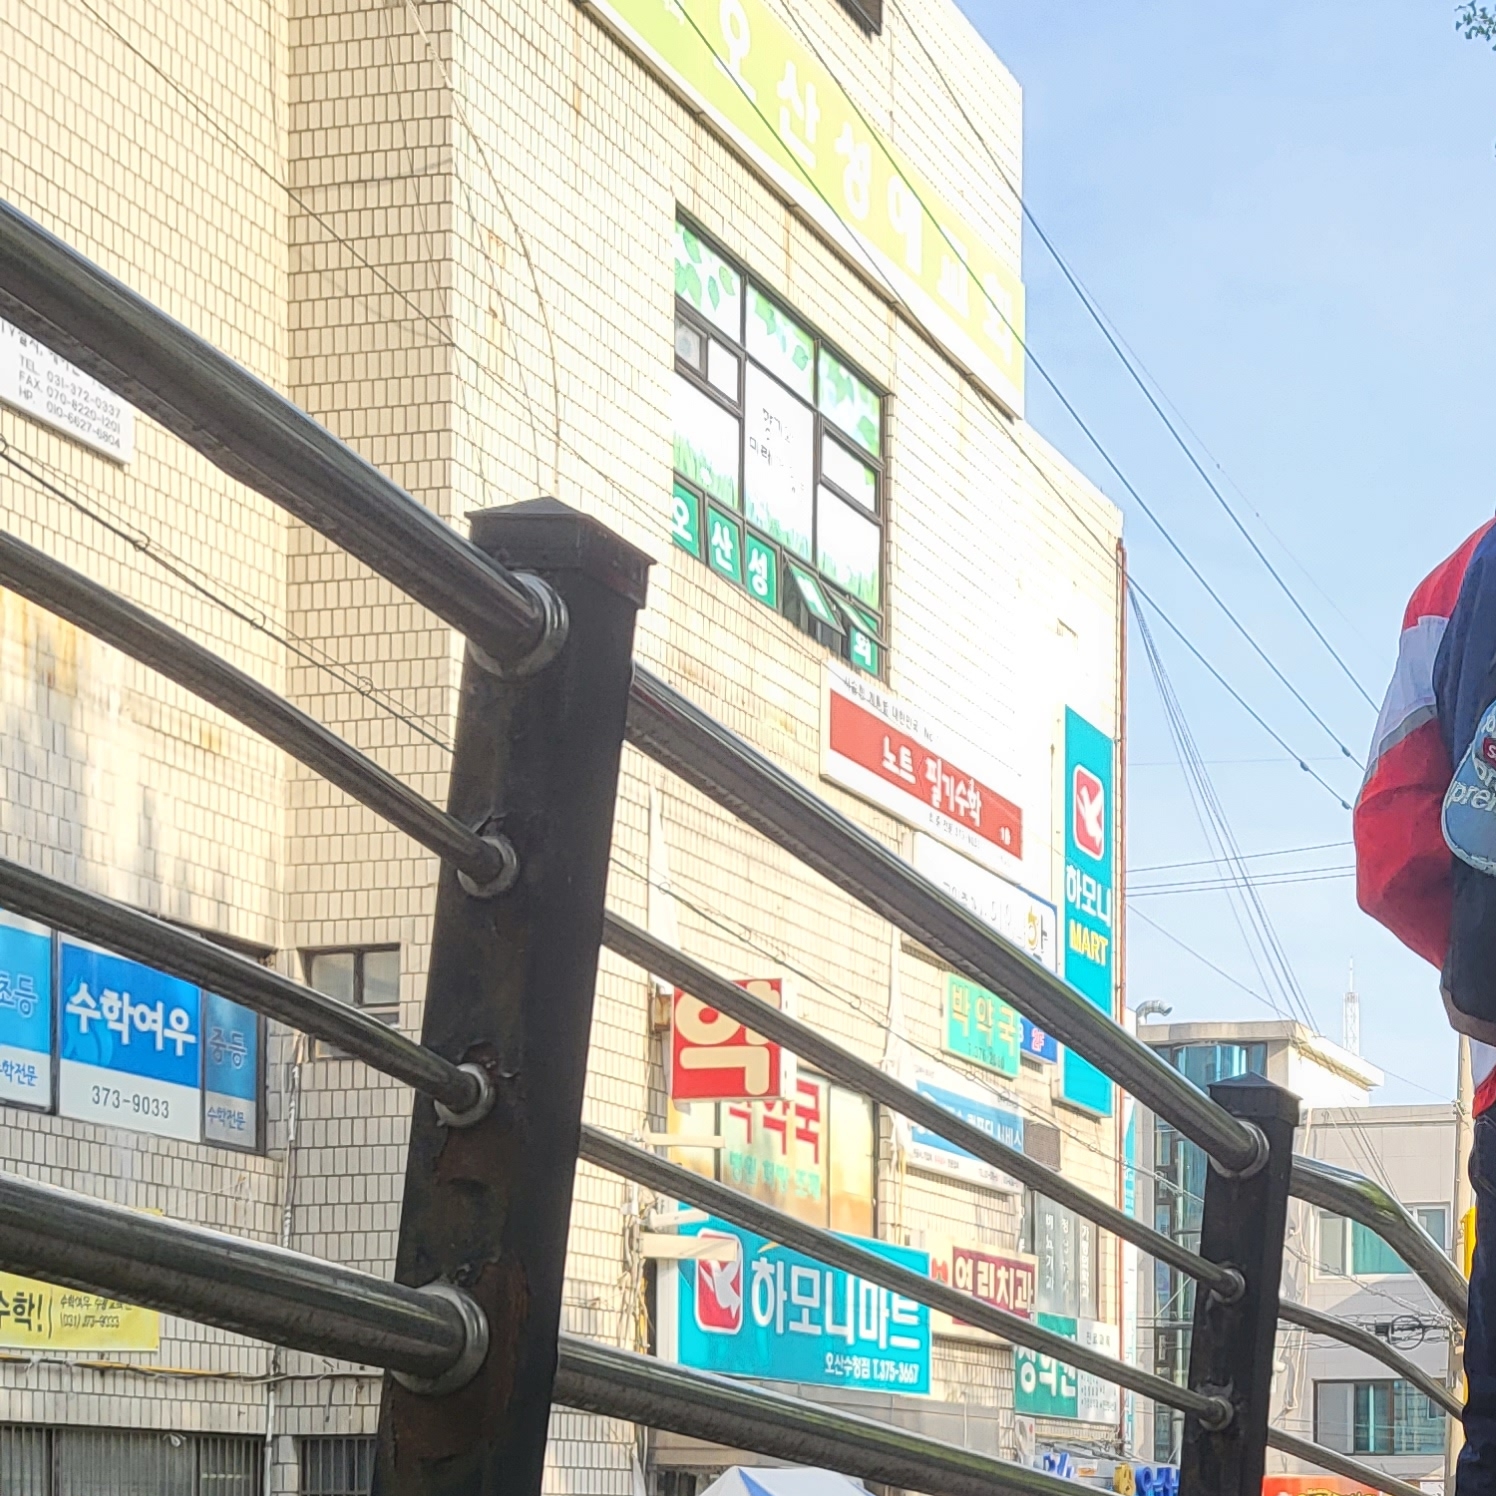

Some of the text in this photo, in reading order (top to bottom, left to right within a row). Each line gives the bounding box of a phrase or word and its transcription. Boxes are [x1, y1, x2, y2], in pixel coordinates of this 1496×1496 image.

[882, 735, 982, 828] 노트 필기수학
[1066, 865, 1111, 927] 하모니
[1069, 918, 1108, 967] MART
[66, 982, 197, 1057] 수학여우
[209, 1026, 248, 1069] 중등
[674, 980, 781, 1096] 약
[952, 983, 1017, 1057] 박약국
[92, 1084, 170, 1119] 373-9033
[207, 1105, 247, 1132] 수학전문
[751, 1257, 921, 1350] 하모니마트
[824, 1352, 870, 1381] 오산수청점
